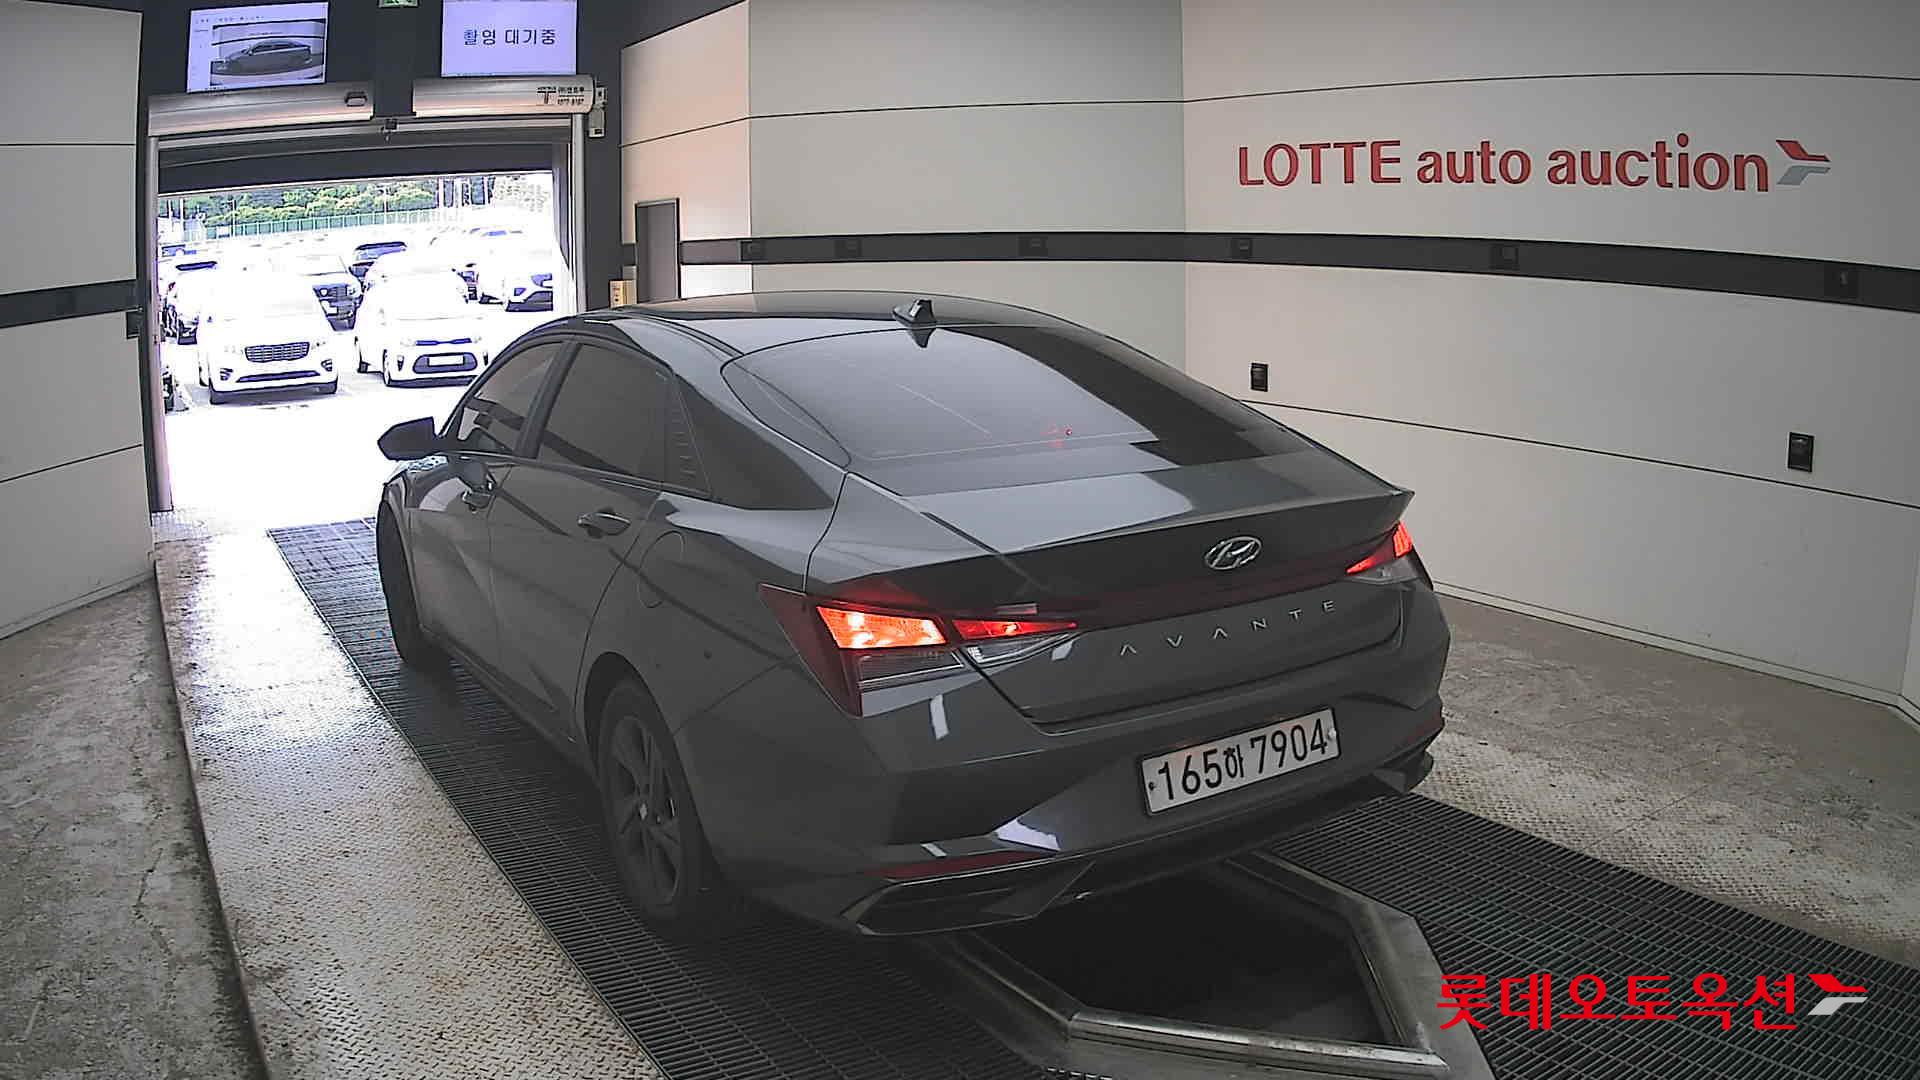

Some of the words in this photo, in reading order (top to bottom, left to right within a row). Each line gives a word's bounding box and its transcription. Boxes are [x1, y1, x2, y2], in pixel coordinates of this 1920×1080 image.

[504, 28, 556, 45] 대기중
[1238, 139, 1401, 187] LOTTE
[1416, 140, 1532, 185] auto
[1547, 132, 1769, 193] auction
[1120, 600, 1336, 656] AVANTE
[1157, 744, 1245, 801] 165하
[1250, 718, 1328, 774] 7904
